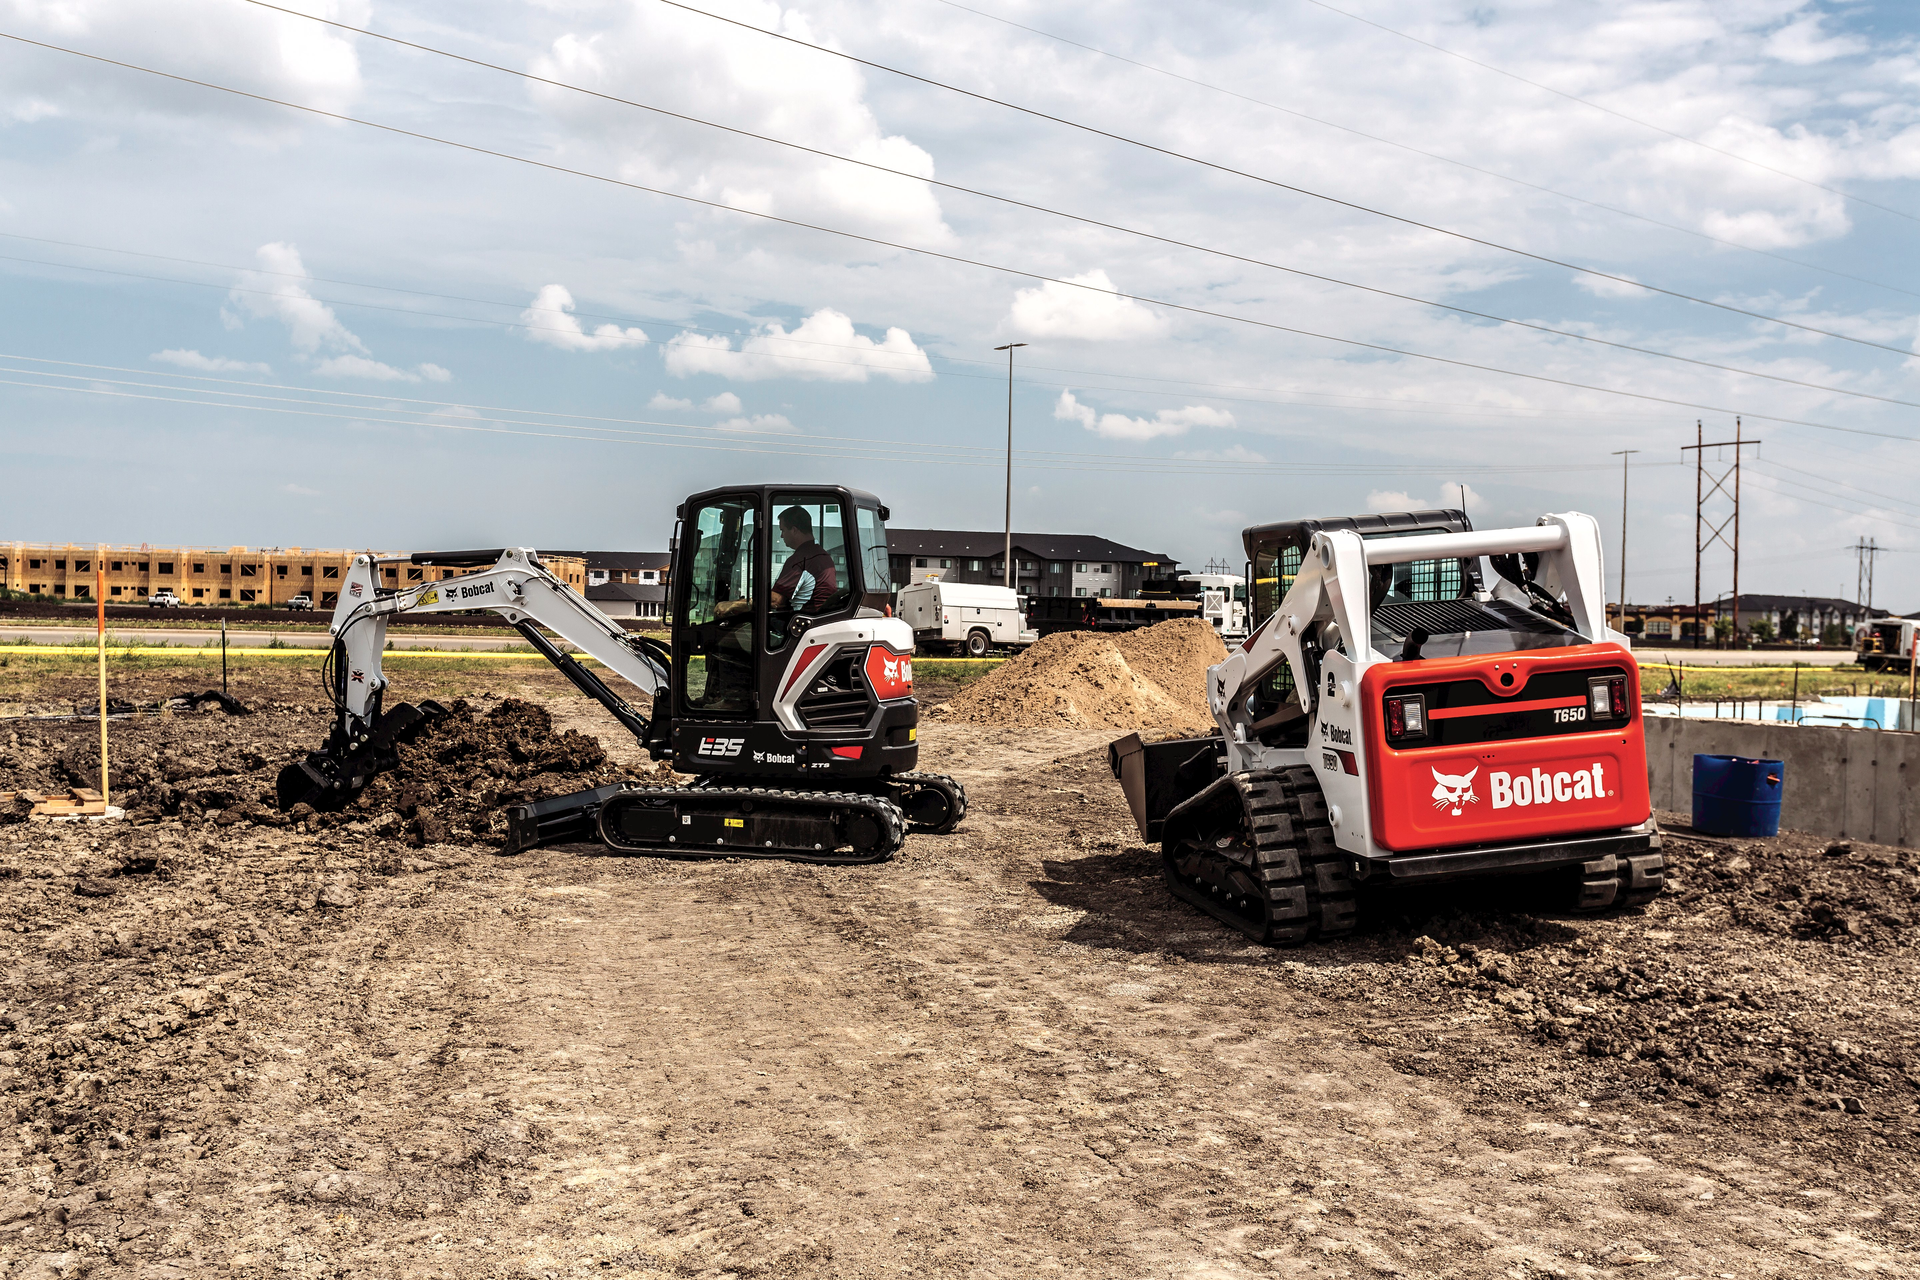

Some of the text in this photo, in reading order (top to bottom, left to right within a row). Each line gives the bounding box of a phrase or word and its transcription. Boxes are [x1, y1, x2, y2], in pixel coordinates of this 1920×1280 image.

[461, 581, 495, 599] Bobcat
[1553, 707, 1586, 723] T650
[1330, 724, 1352, 745] Bobcat
[698, 737, 745, 757] E35
[766, 753, 795, 764] Bobcat
[1490, 762, 1606, 809] Bobcat
